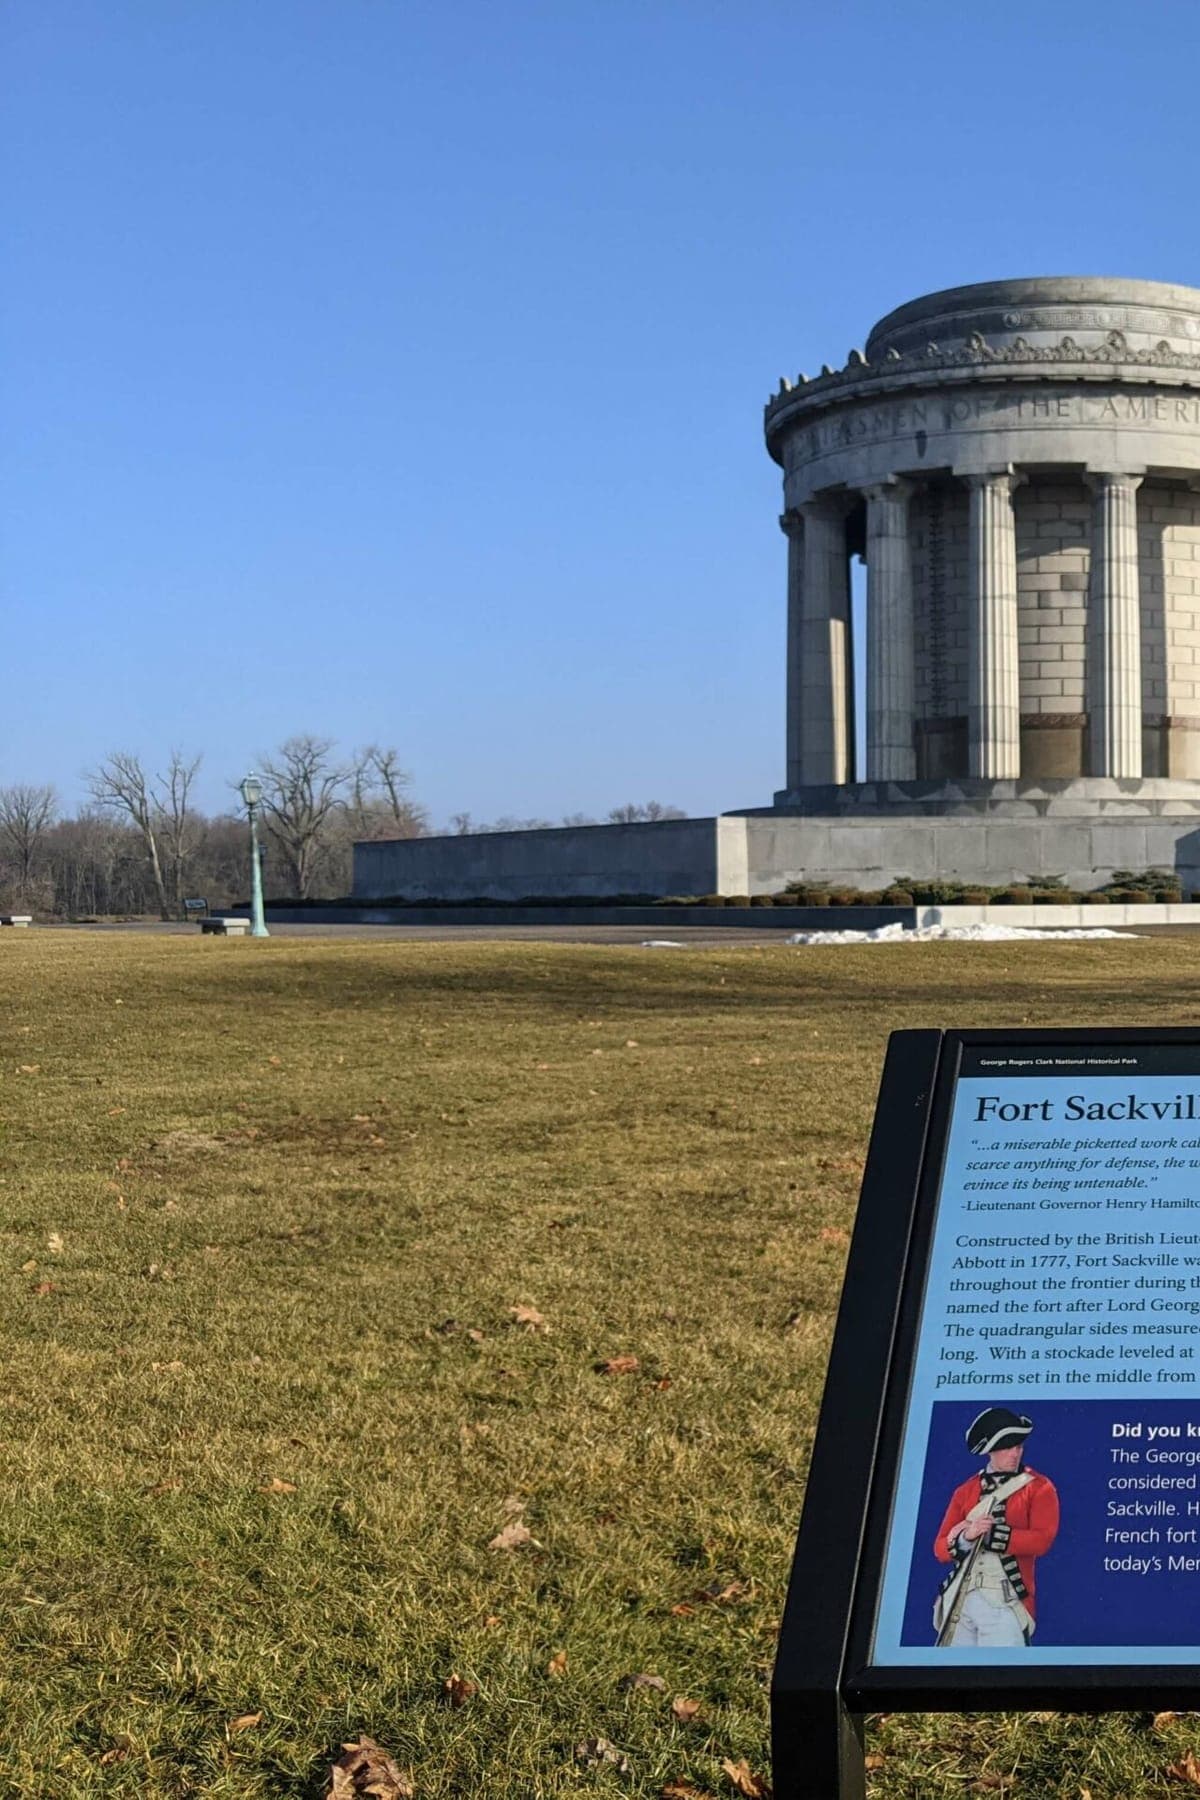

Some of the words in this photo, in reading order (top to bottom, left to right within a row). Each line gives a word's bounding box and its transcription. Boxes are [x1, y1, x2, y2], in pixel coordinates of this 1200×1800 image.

[1015, 398, 1071, 419] THE
[973, 1096, 1054, 1121] Fort
[962, 1178, 1009, 1190] evince
[1011, 1177, 1029, 1189] its
[1031, 1177, 1072, 1192] being
[1039, 1198, 1102, 1209] Governor
[1105, 1198, 1147, 1211] Henry
[955, 1233, 1050, 1247] Constructed
[1054, 1233, 1073, 1249] by
[1077, 1232, 1101, 1245] the
[1105, 1232, 1154, 1245] British
[951, 1255, 1007, 1269] Abbott
[1009, 1255, 1025, 1268] in
[1030, 1255, 1071, 1269] 1777,
[1075, 1254, 1107, 1267] Fort
[1111, 1253, 1179, 1266] Sackville
[945, 1299, 999, 1314] named
[1004, 1299, 1029, 1313] the
[1032, 1299, 1062, 1312] fort
[1065, 1298, 1103, 1312] after
[1107, 1298, 1145, 1311] Lord
[943, 1323, 974, 1337] The
[978, 1321, 1085, 1340] quadrangular
[1088, 1321, 1128, 1335] sides
[935, 1369, 1013, 1389] platforms
[1017, 1372, 1040, 1383] set
[1044, 1369, 1060, 1383] in
[1065, 1368, 1091, 1383] the
[1095, 1368, 1152, 1383] middle
[1156, 1368, 1195, 1382] from
[1112, 1422, 1141, 1437] Did
[1147, 1426, 1180, 1440] you
[1110, 1448, 1139, 1463] The
[1108, 1473, 1196, 1489] considered
[1106, 1500, 1179, 1516] Sackville.
[1105, 1527, 1159, 1543] French
[1166, 1526, 1196, 1543] fort
